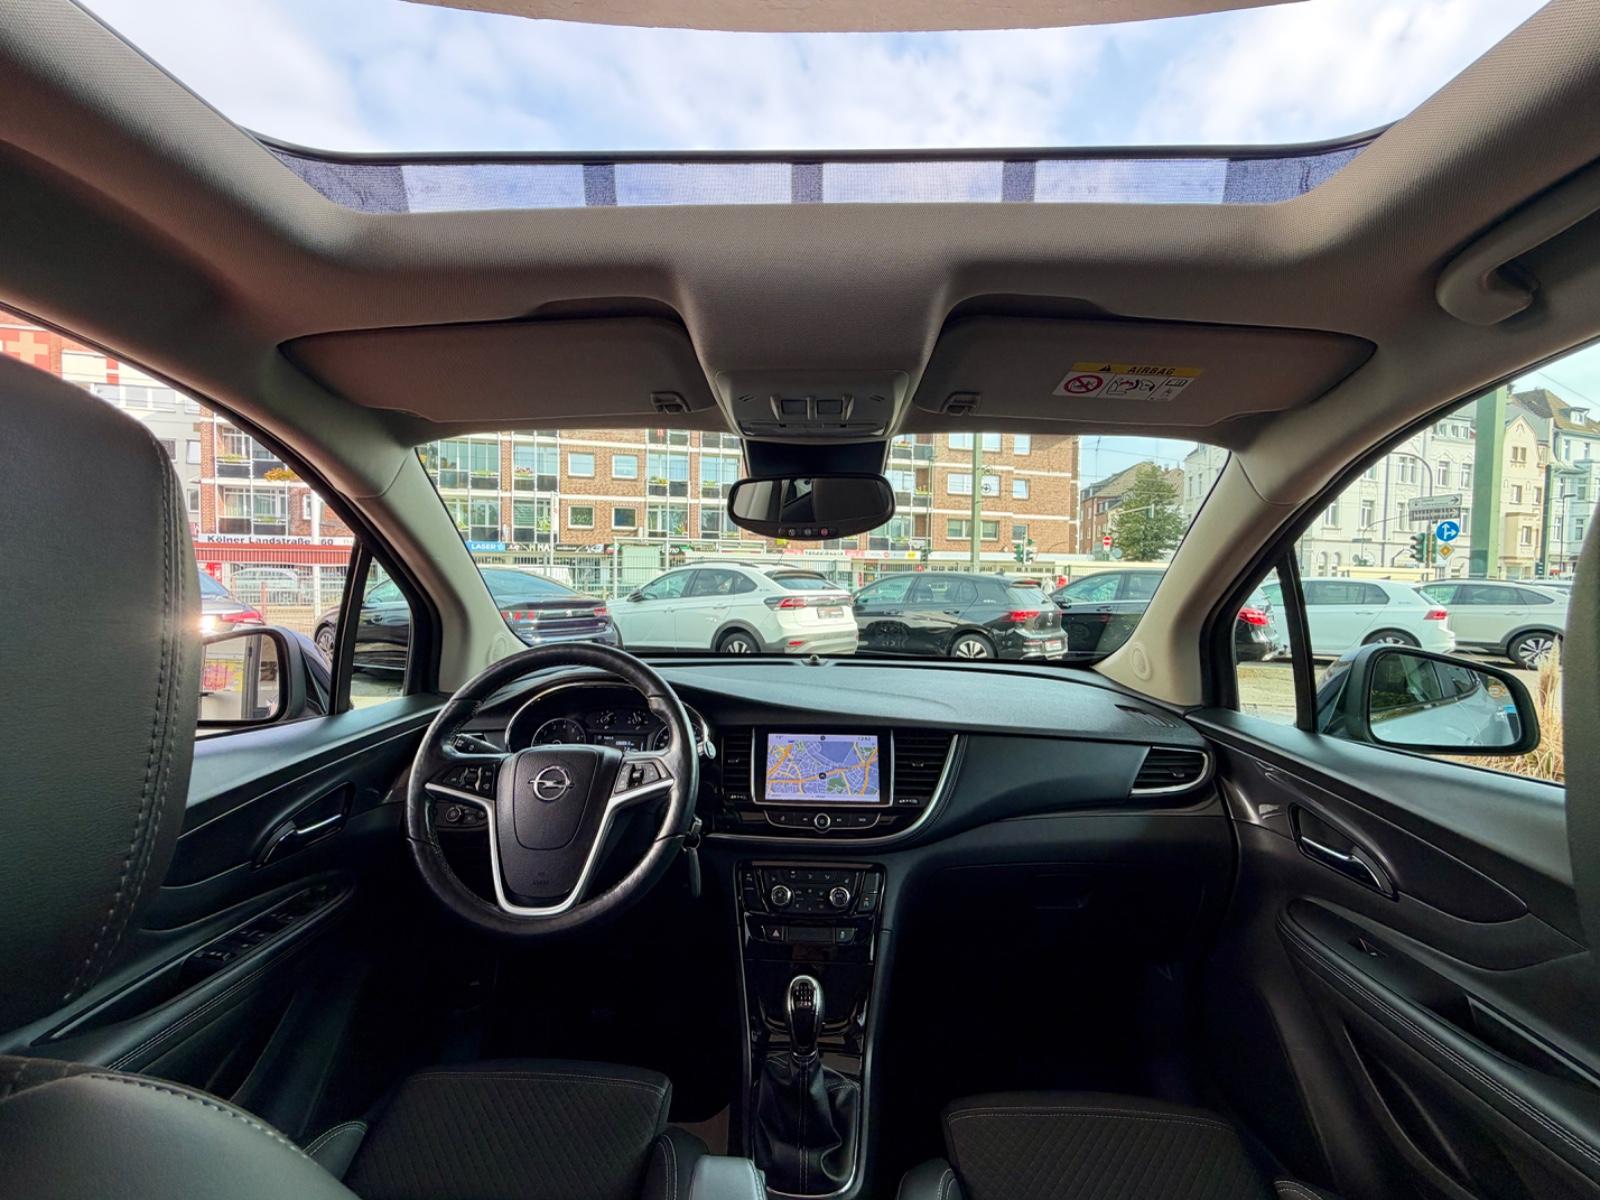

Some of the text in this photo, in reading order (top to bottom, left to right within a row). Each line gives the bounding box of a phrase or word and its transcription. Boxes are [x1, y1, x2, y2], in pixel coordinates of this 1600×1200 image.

[1127, 366, 1176, 375] AIRBAG
[207, 535, 245, 544] Kölner
[250, 536, 311, 545] Landstraße
